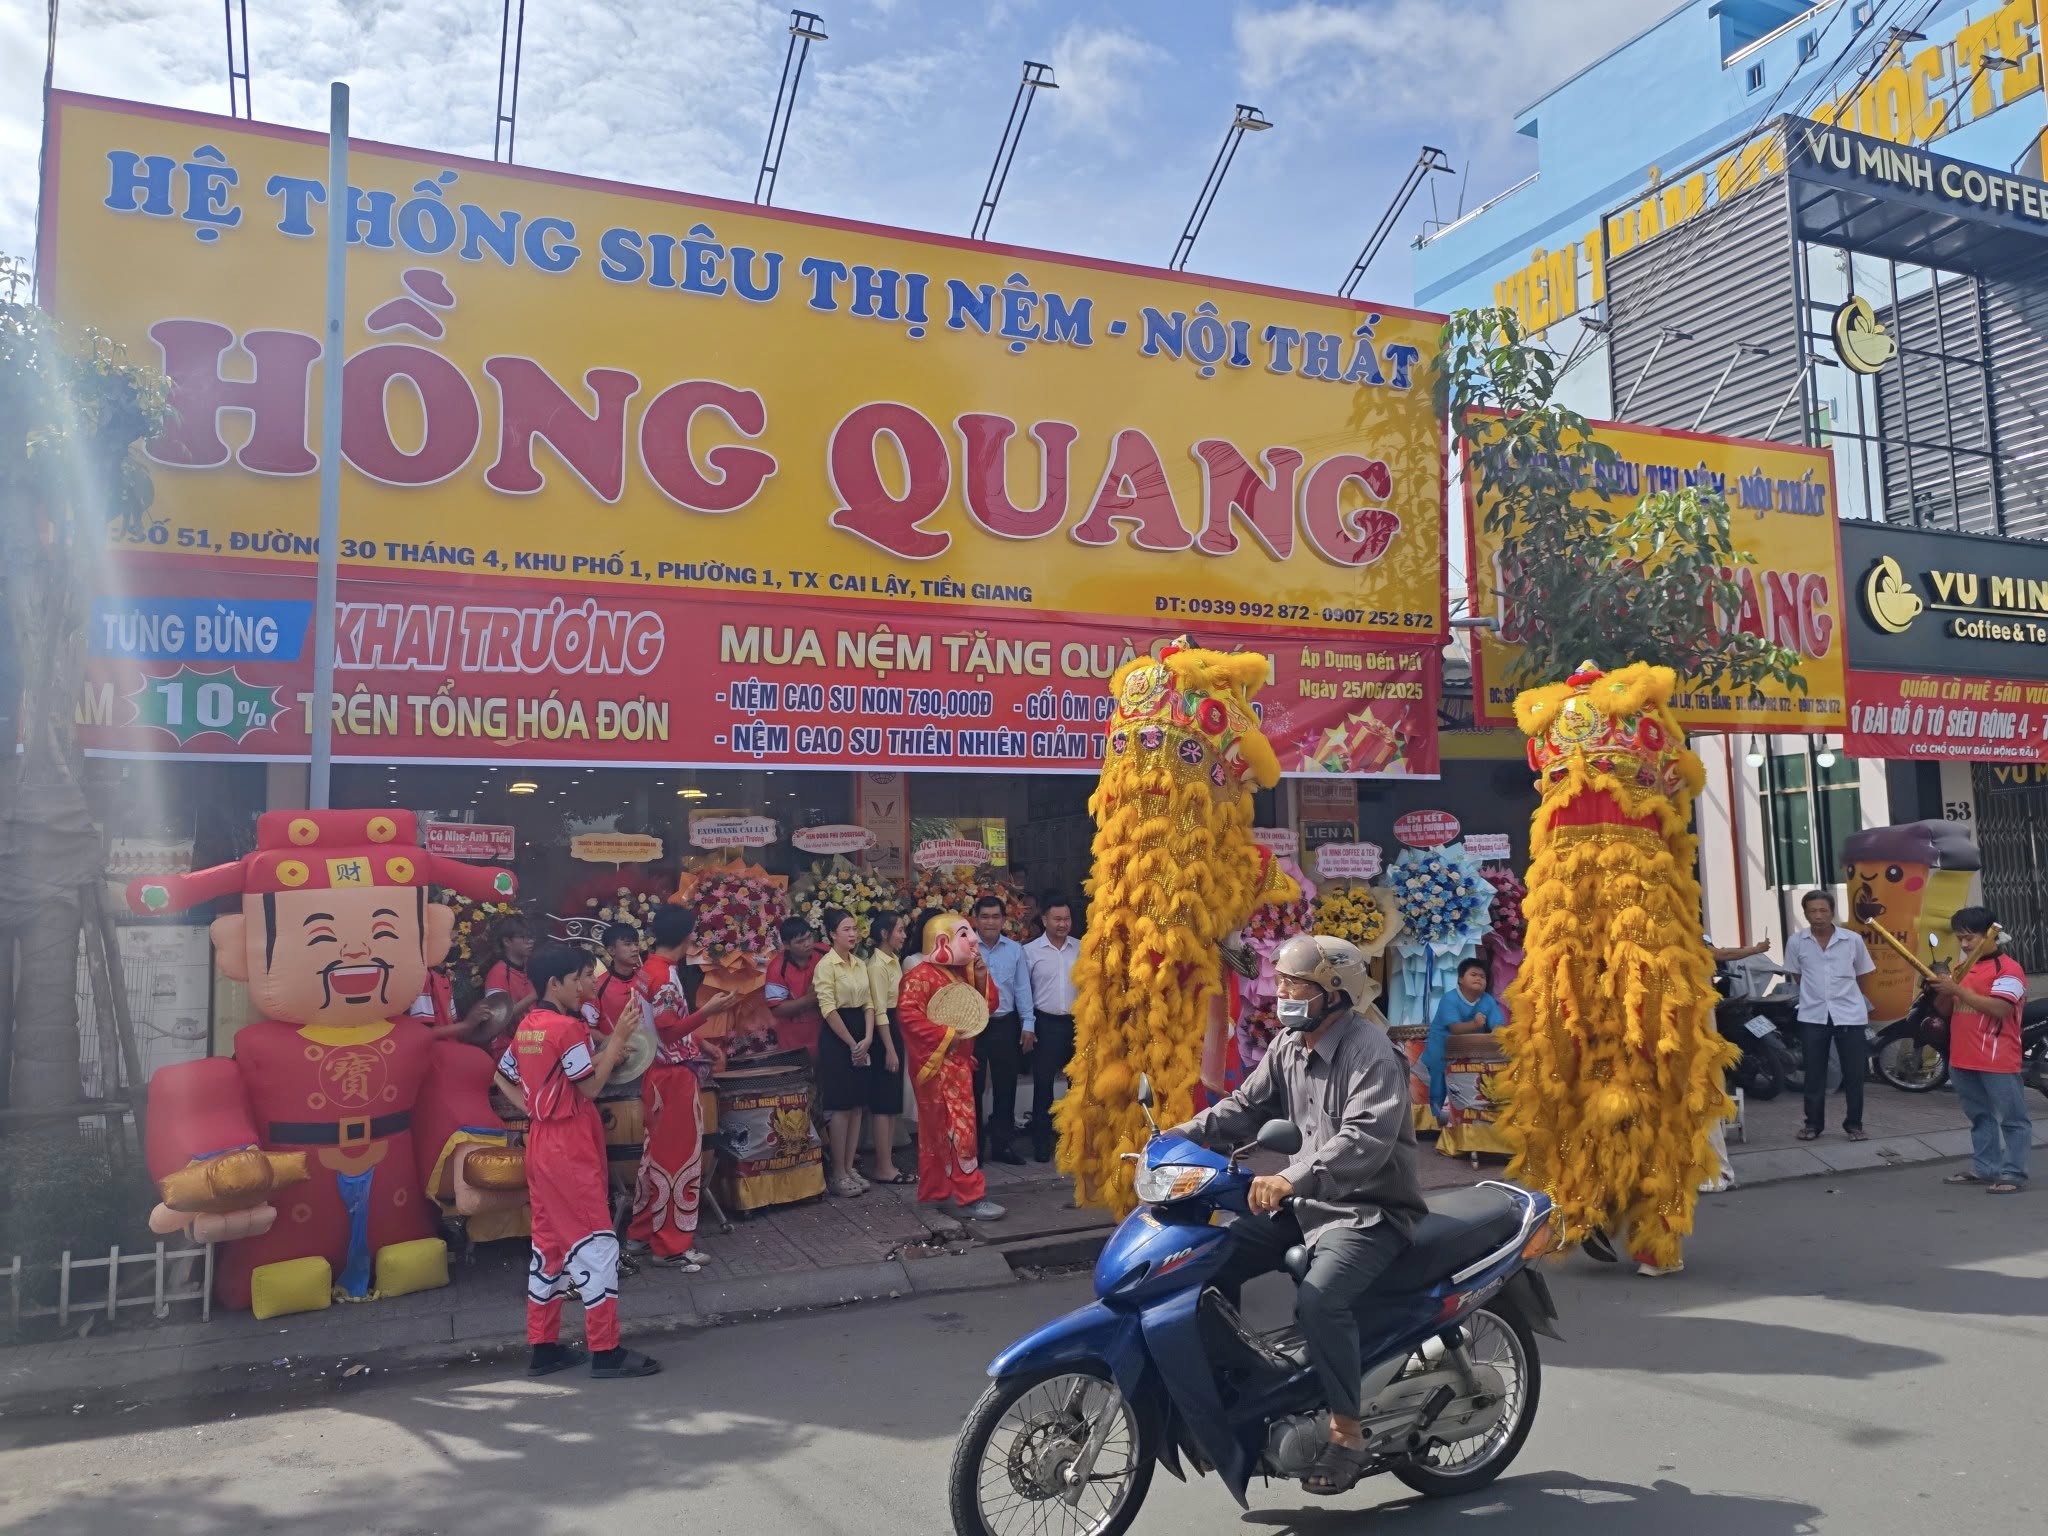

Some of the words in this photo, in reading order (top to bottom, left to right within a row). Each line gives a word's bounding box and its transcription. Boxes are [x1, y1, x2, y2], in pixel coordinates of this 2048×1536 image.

[1804, 127, 1851, 169] VU
[1857, 140, 1934, 191] MINH
[104, 145, 241, 242] HỆ
[266, 171, 581, 272] THỐNG
[600, 224, 784, 302] SIÊU
[800, 257, 929, 338] THỊ
[946, 272, 1094, 353] NỆM
[1108, 320, 1128, 336] -
[1140, 302, 1251, 377] NỘI
[1262, 313, 1419, 390] THẤT
[143, 268, 778, 514] HỒNG
[828, 402, 1400, 566] QUANG
[1738, 466, 1774, 520] NỘI
[1776, 468, 1826, 517] THẤT
[177, 528, 222, 553] 51,
[340, 539, 377, 559] 30
[384, 540, 475, 566] THÁNG
[482, 550, 508, 572] 4,
[514, 551, 566, 572] KHU
[572, 550, 626, 576] PHỐ
[630, 560, 651, 581] 1,
[657, 560, 757, 585] PHƯỜNG
[762, 569, 782, 589] 1,
[829, 573, 866, 592] CAI
[871, 573, 916, 599] LẬY,
[920, 574, 966, 598] TIỀN
[971, 583, 1033, 603] GIANG
[1930, 570, 1978, 605] VU
[1155, 596, 1186, 613] ĐT:
[1189, 598, 1236, 616] 0939
[1239, 601, 1274, 618] 992
[1277, 604, 1310, 620] 872
[1322, 607, 1365, 624] 0907
[1368, 611, 1399, 626] 252
[1403, 613, 1434, 629] 872
[195, 603, 279, 654] BỪNG
[332, 602, 454, 670] KHAI
[460, 597, 665, 675] TRƯƠNG
[720, 624, 826, 667] MUA
[836, 623, 932, 679] NỆM
[941, 630, 1051, 683] TẶNG
[1301, 645, 1320, 669] Áp
[1325, 650, 1362, 672] Dụng
[1366, 650, 1395, 671] Đến
[1399, 651, 1422, 671] Hết
[156, 682, 267, 727] 10%
[783, 683, 824, 713] CAO
[829, 685, 856, 714] SU
[860, 686, 902, 715] NON
[907, 689, 993, 719] 790,000Đ
[1062, 689, 1091, 722] ÔM
[1300, 679, 1338, 699] Ngày
[1900, 676, 1939, 698] QUÁN
[1942, 677, 1961, 699] CÀ
[1963, 680, 1991, 701] PHÊ
[1993, 681, 2022, 702] SÂN
[297, 682, 398, 735] TRÊN
[407, 678, 507, 738] TỔNG
[516, 689, 590, 740] HÓA
[596, 696, 669, 741] ĐƠN
[1862, 702, 1888, 734] BÃI
[1891, 700, 1911, 735] ĐỖ
[1912, 704, 1924, 736] Ô
[1926, 705, 1945, 736] TÔ
[1946, 706, 1978, 738] SIÊU
[1978, 708, 2017, 743] RỘNG
[2018, 713, 2029, 740] 4
[795, 727, 845, 755] CAO
[849, 727, 881, 755] SU
[887, 725, 952, 757] THIÊN
[958, 727, 1027, 759] NHIÊN
[1032, 726, 1087, 760] GIẢM
[1948, 745, 1972, 756] QUAY
[1994, 764, 2028, 784] VU
[1945, 801, 1971, 821] 53
